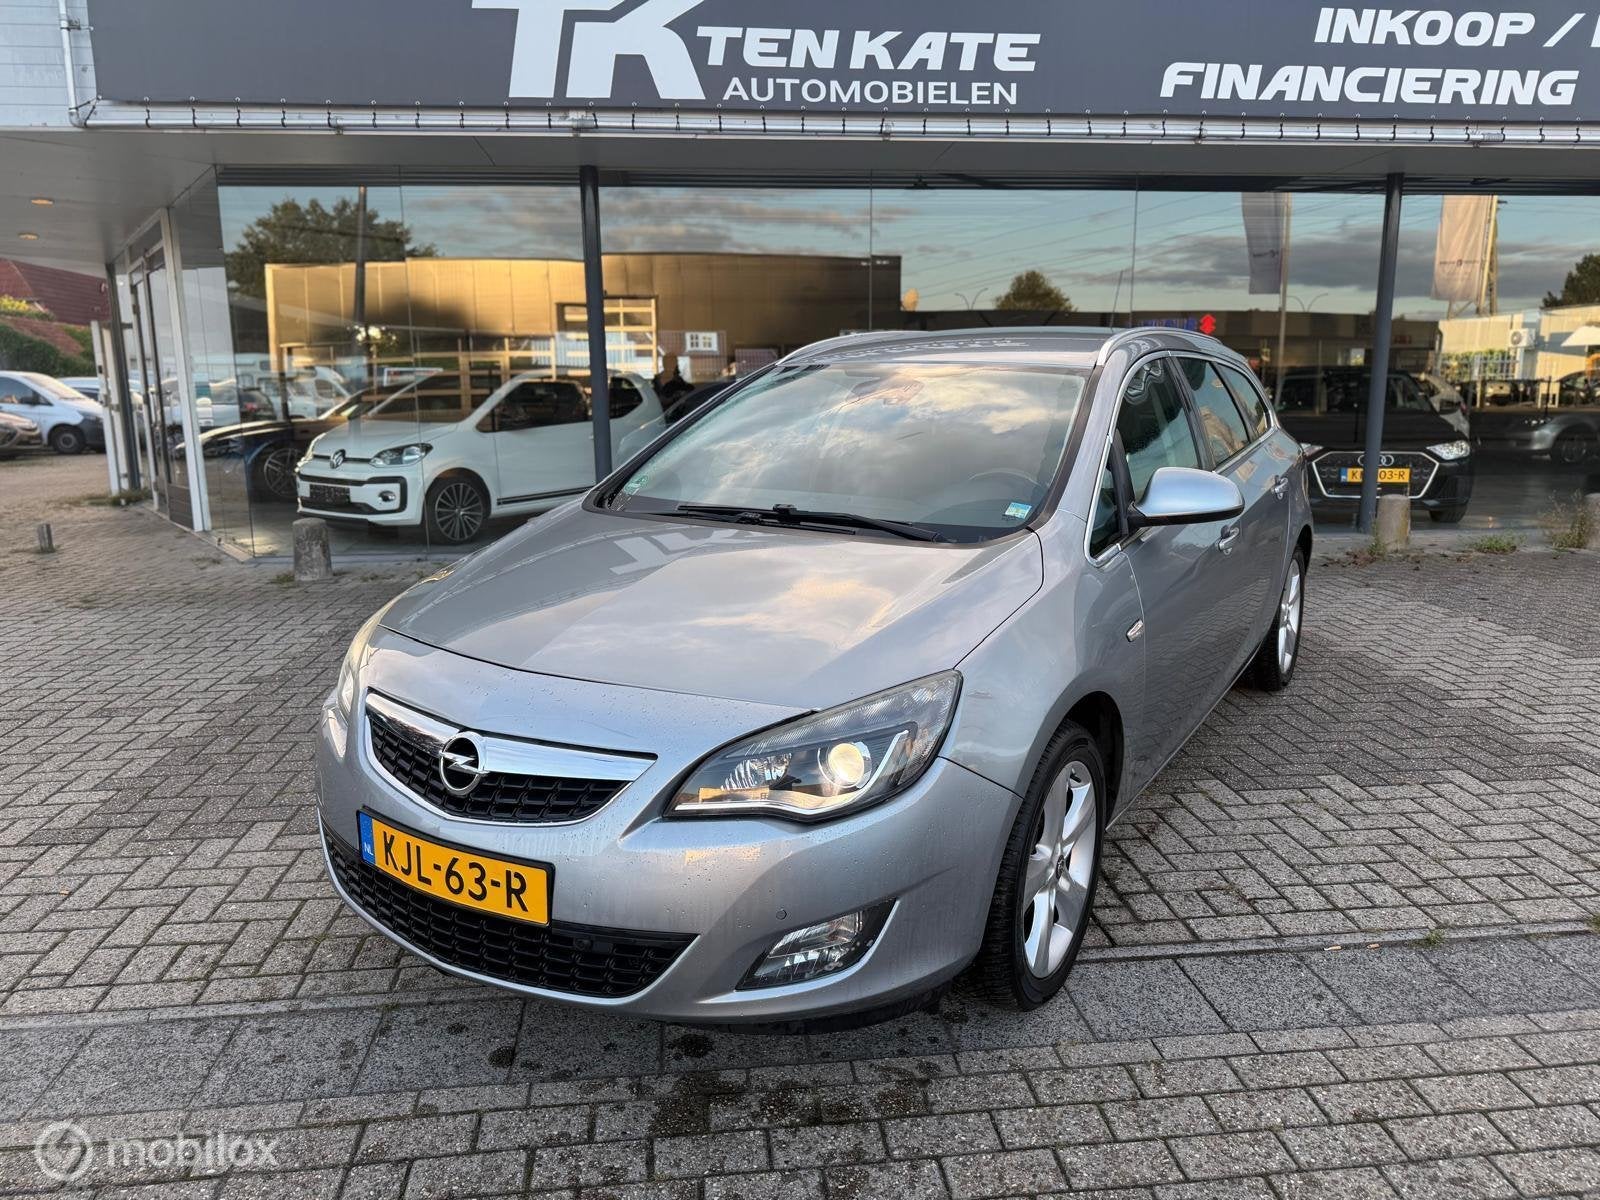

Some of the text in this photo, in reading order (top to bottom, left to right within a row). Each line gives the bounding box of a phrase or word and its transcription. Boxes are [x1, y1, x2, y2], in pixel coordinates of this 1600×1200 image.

[1314, 7, 1536, 47] INKOOP
[697, 26, 1041, 71] TEN KATE
[723, 77, 1018, 106] AUTOMOBIELEN
[1160, 62, 1580, 105] FINANCIERING
[363, 842, 375, 856] NL
[382, 831, 529, 912] KJL-63-R
